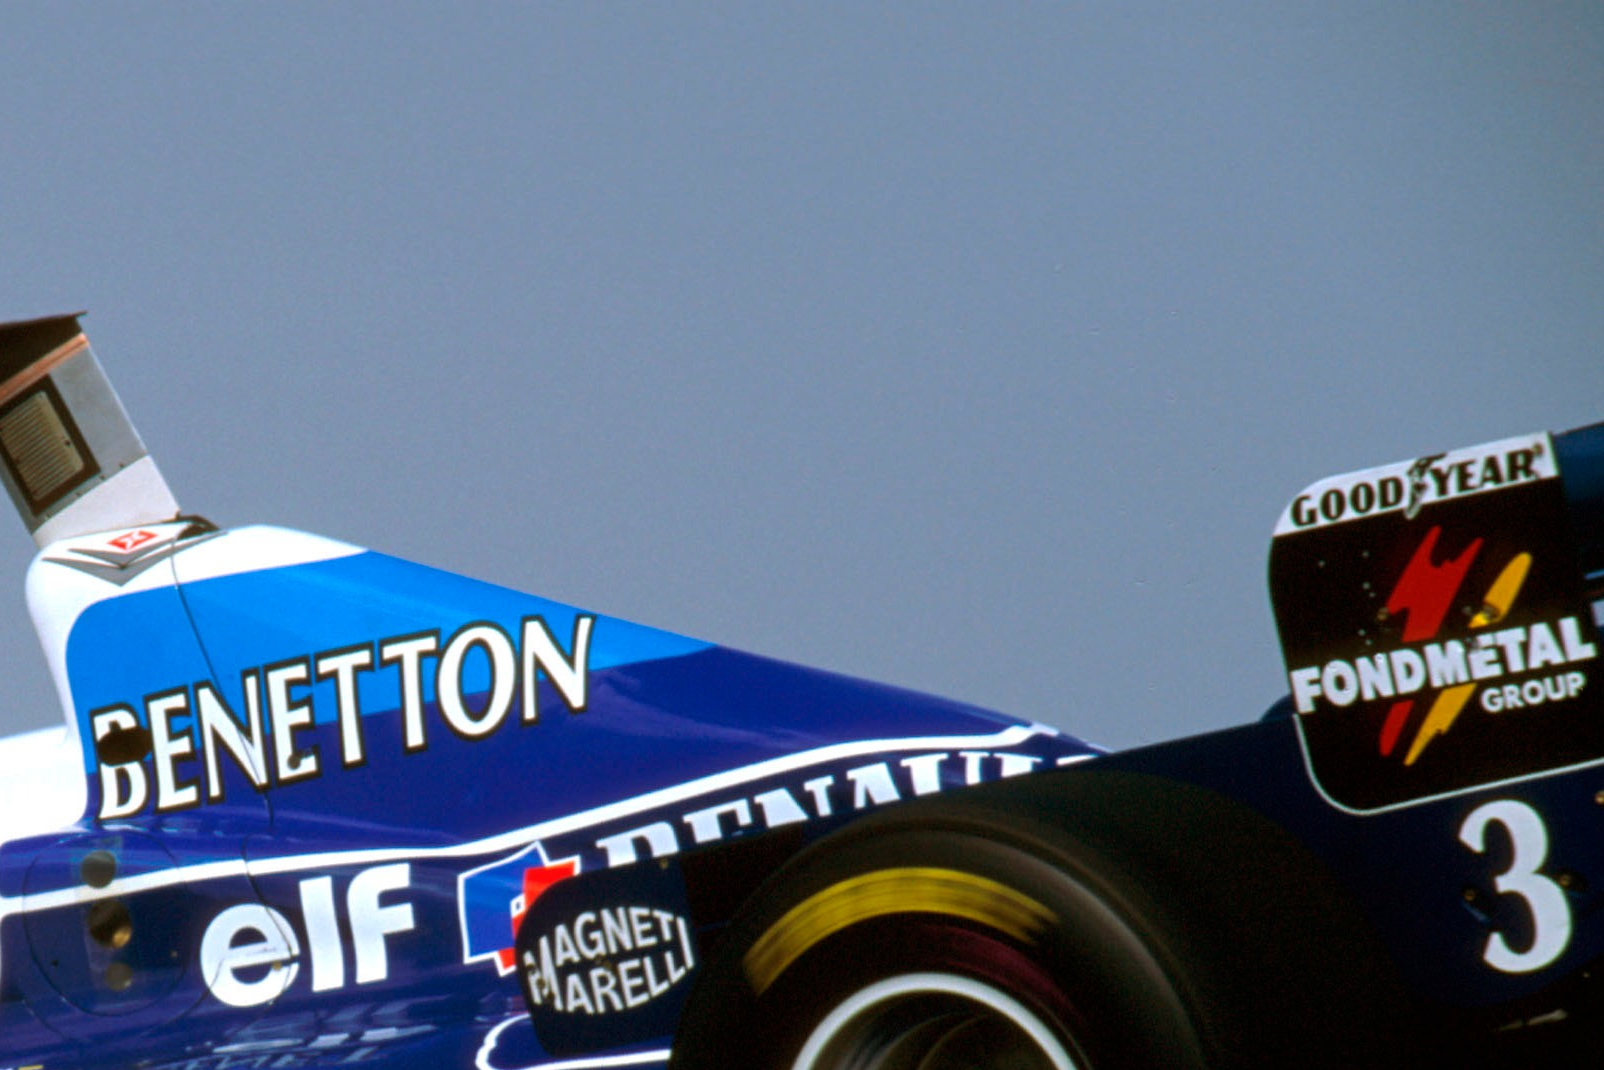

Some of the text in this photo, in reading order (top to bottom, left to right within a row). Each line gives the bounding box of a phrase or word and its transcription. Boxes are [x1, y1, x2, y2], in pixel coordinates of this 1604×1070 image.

[92, 616, 594, 822] BENETTON
[1291, 616, 1596, 714] FONDMETAL
[1481, 672, 1586, 712] GROUP
[200, 863, 415, 1007] elf
[1459, 800, 1572, 973] 3
